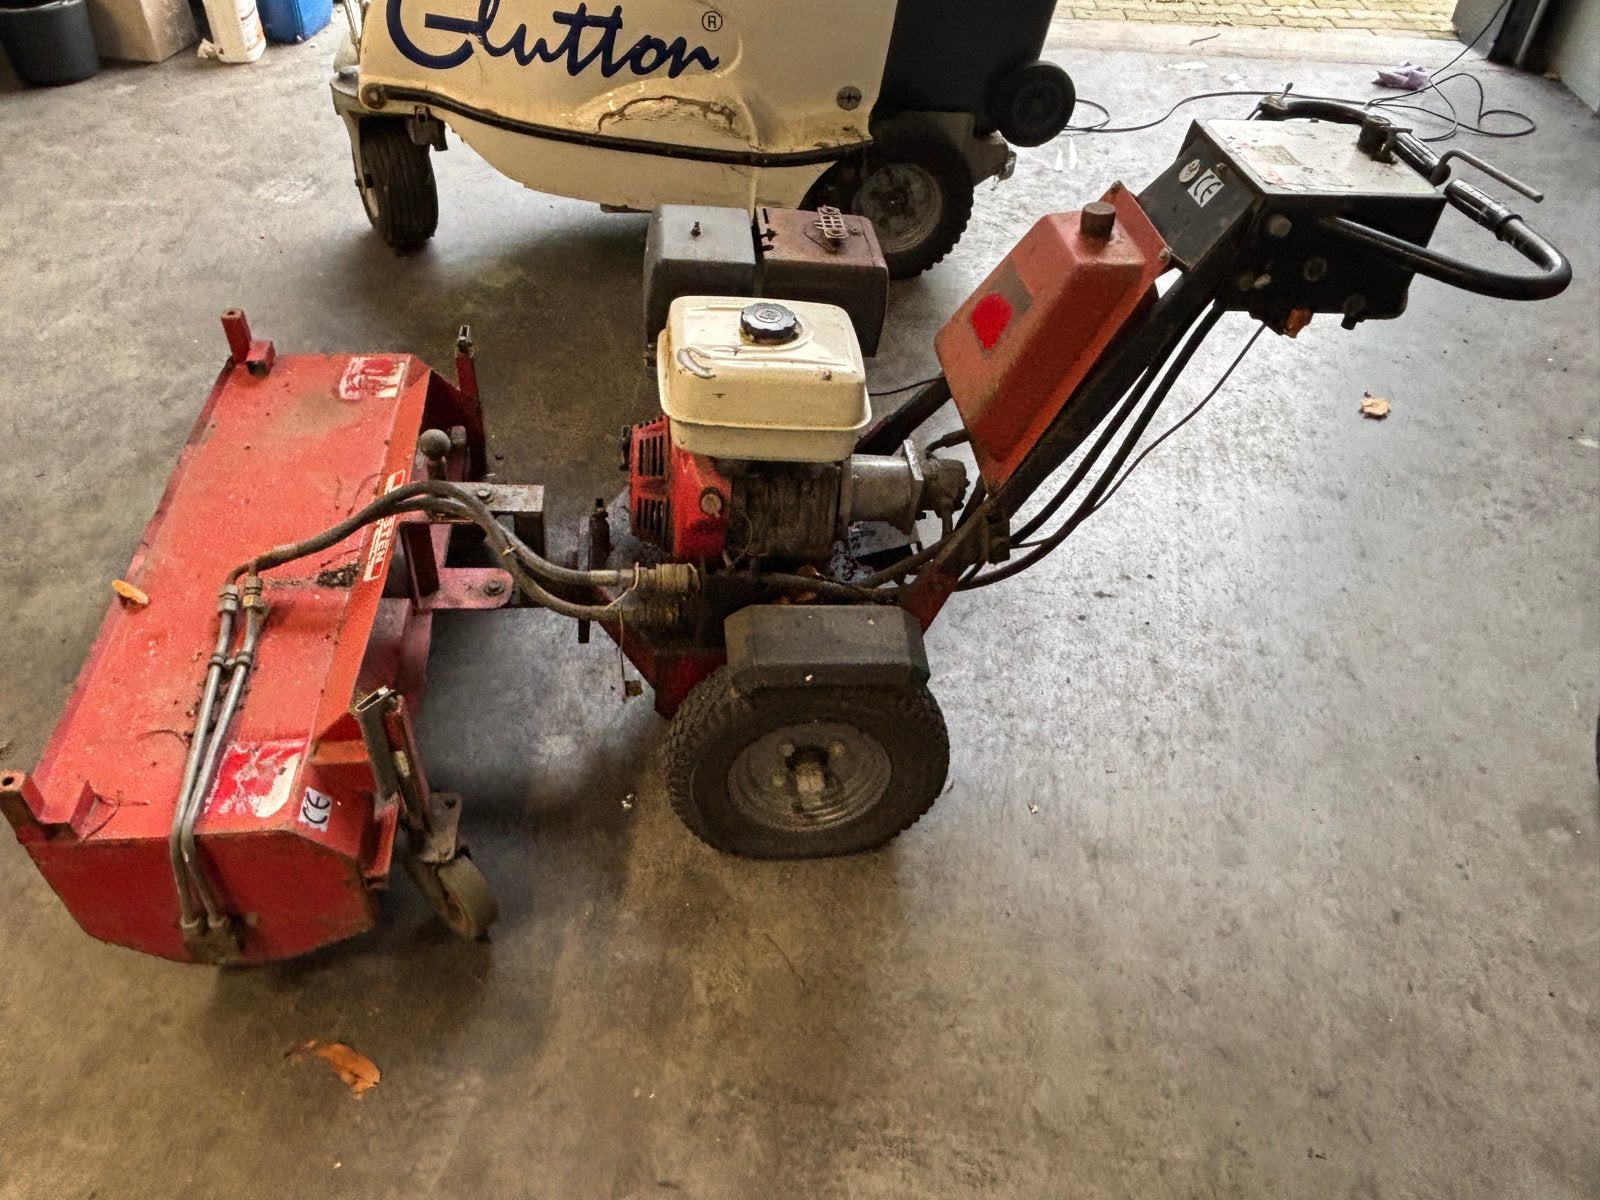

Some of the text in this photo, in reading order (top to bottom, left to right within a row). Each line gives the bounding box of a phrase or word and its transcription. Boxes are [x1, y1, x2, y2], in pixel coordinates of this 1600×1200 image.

[386, 0, 720, 79] Glutton
[1193, 173, 1222, 204] CE
[302, 791, 331, 824] CE
